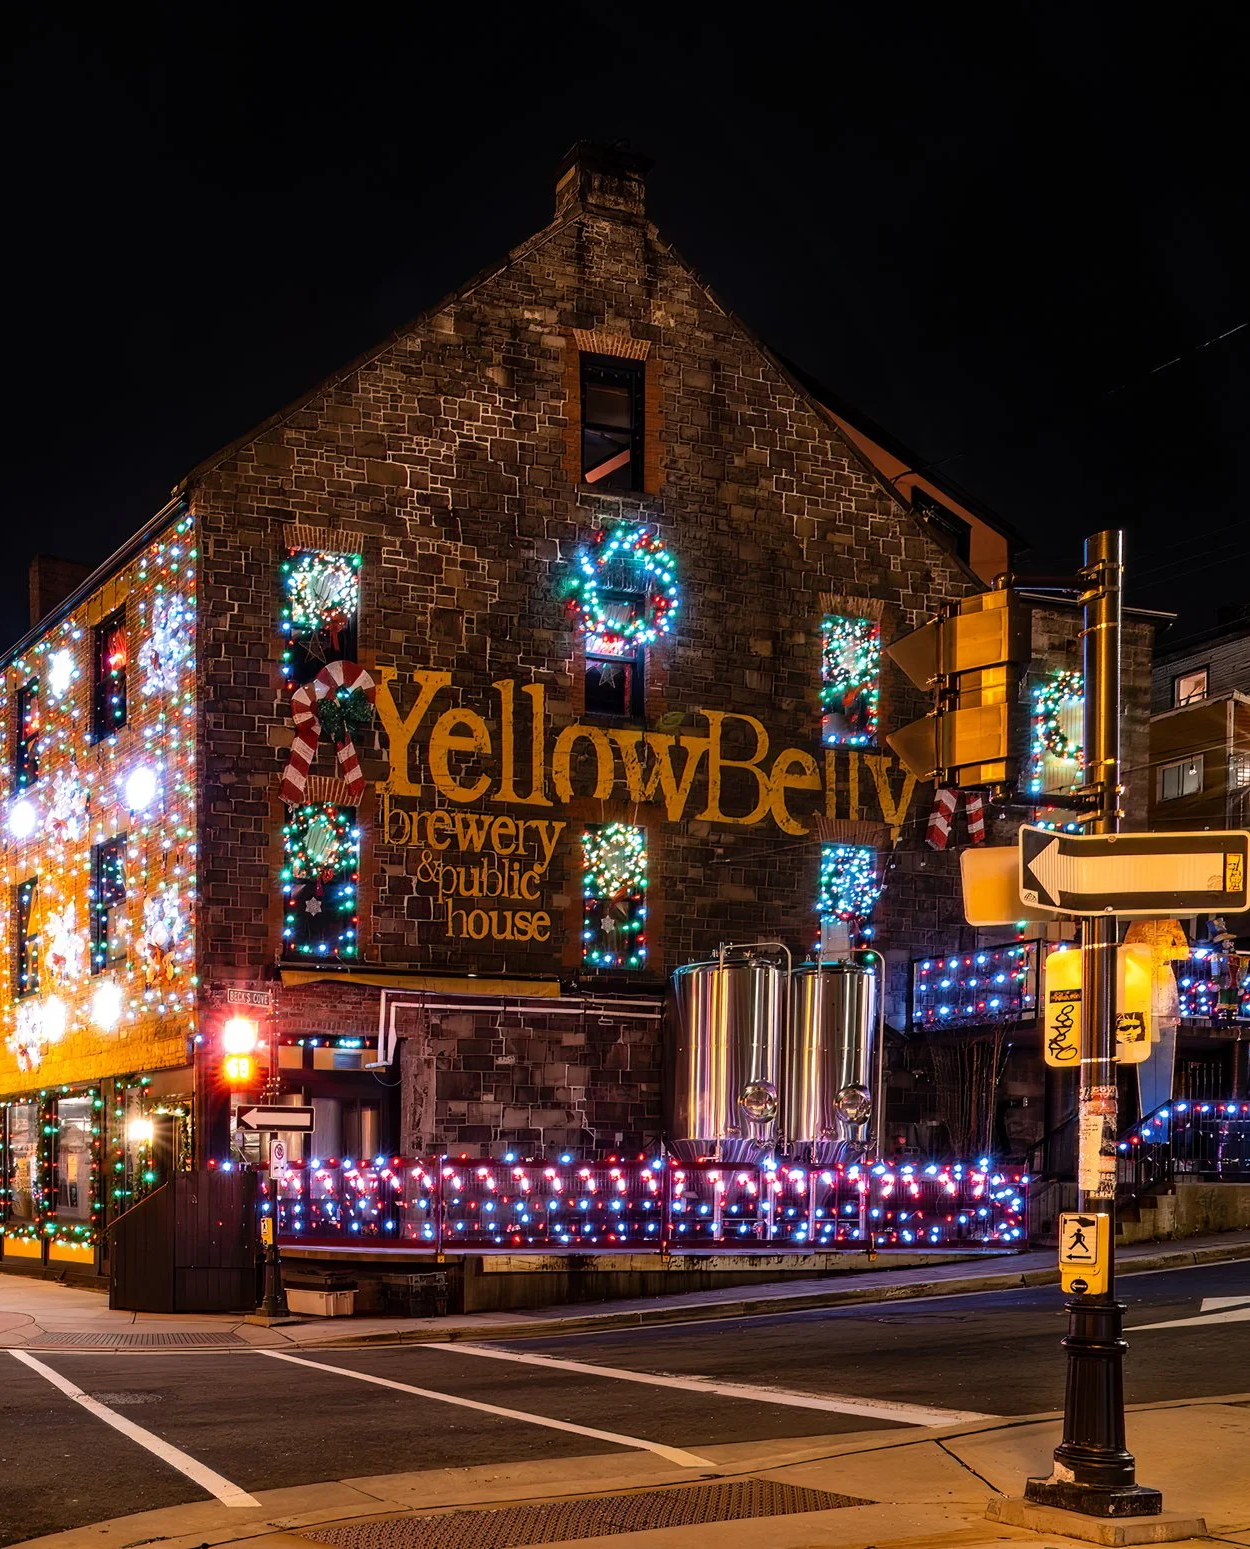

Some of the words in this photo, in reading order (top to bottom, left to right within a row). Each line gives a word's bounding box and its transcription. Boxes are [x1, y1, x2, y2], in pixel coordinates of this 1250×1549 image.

[374, 665, 918, 850] YellowBelly
[382, 792, 567, 874] brewery
[445, 897, 551, 942] house
[229, 991, 251, 1004] BECK'S
[253, 992, 269, 1005] COVE
